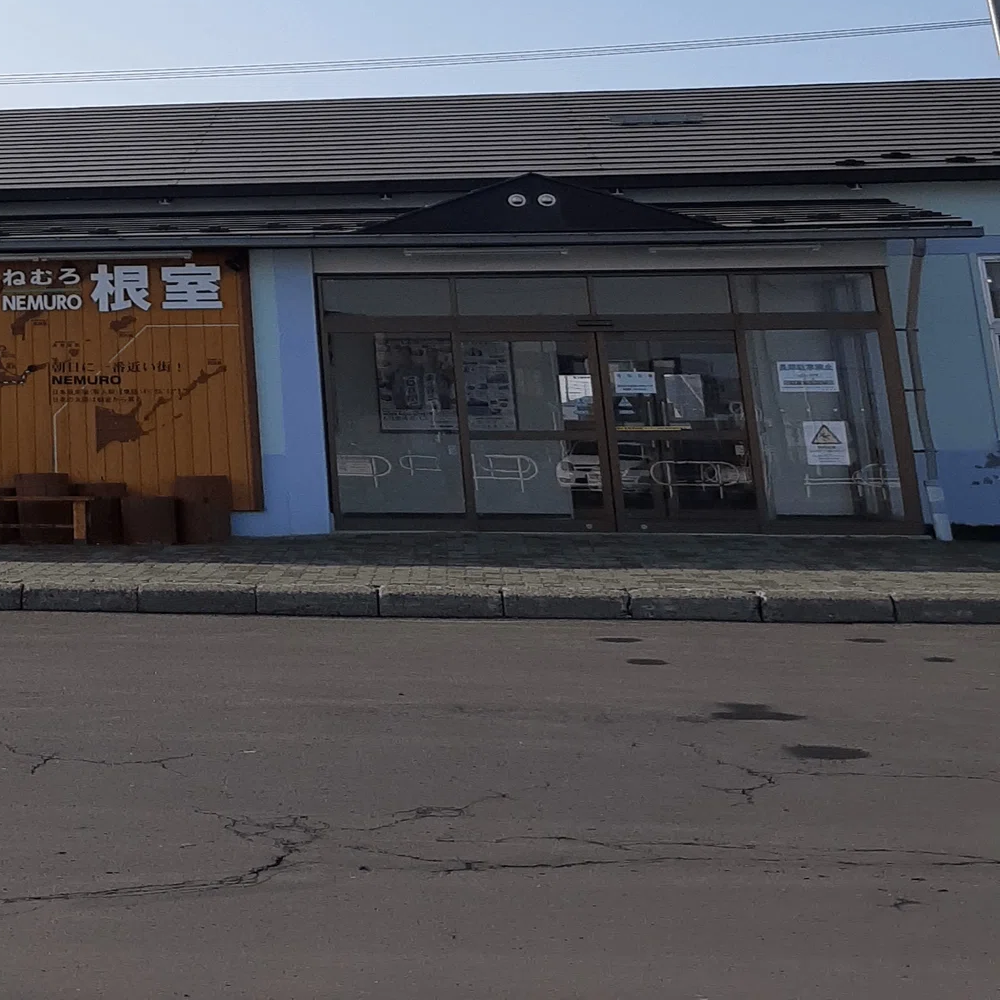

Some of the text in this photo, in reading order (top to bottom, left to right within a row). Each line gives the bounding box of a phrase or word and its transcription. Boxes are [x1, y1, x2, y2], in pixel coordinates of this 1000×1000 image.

[2, 267, 81, 287] ねむろ
[90, 262, 224, 313] 根室
[2, 294, 83, 312] NEMURO
[51, 375, 122, 385] NEMURO
